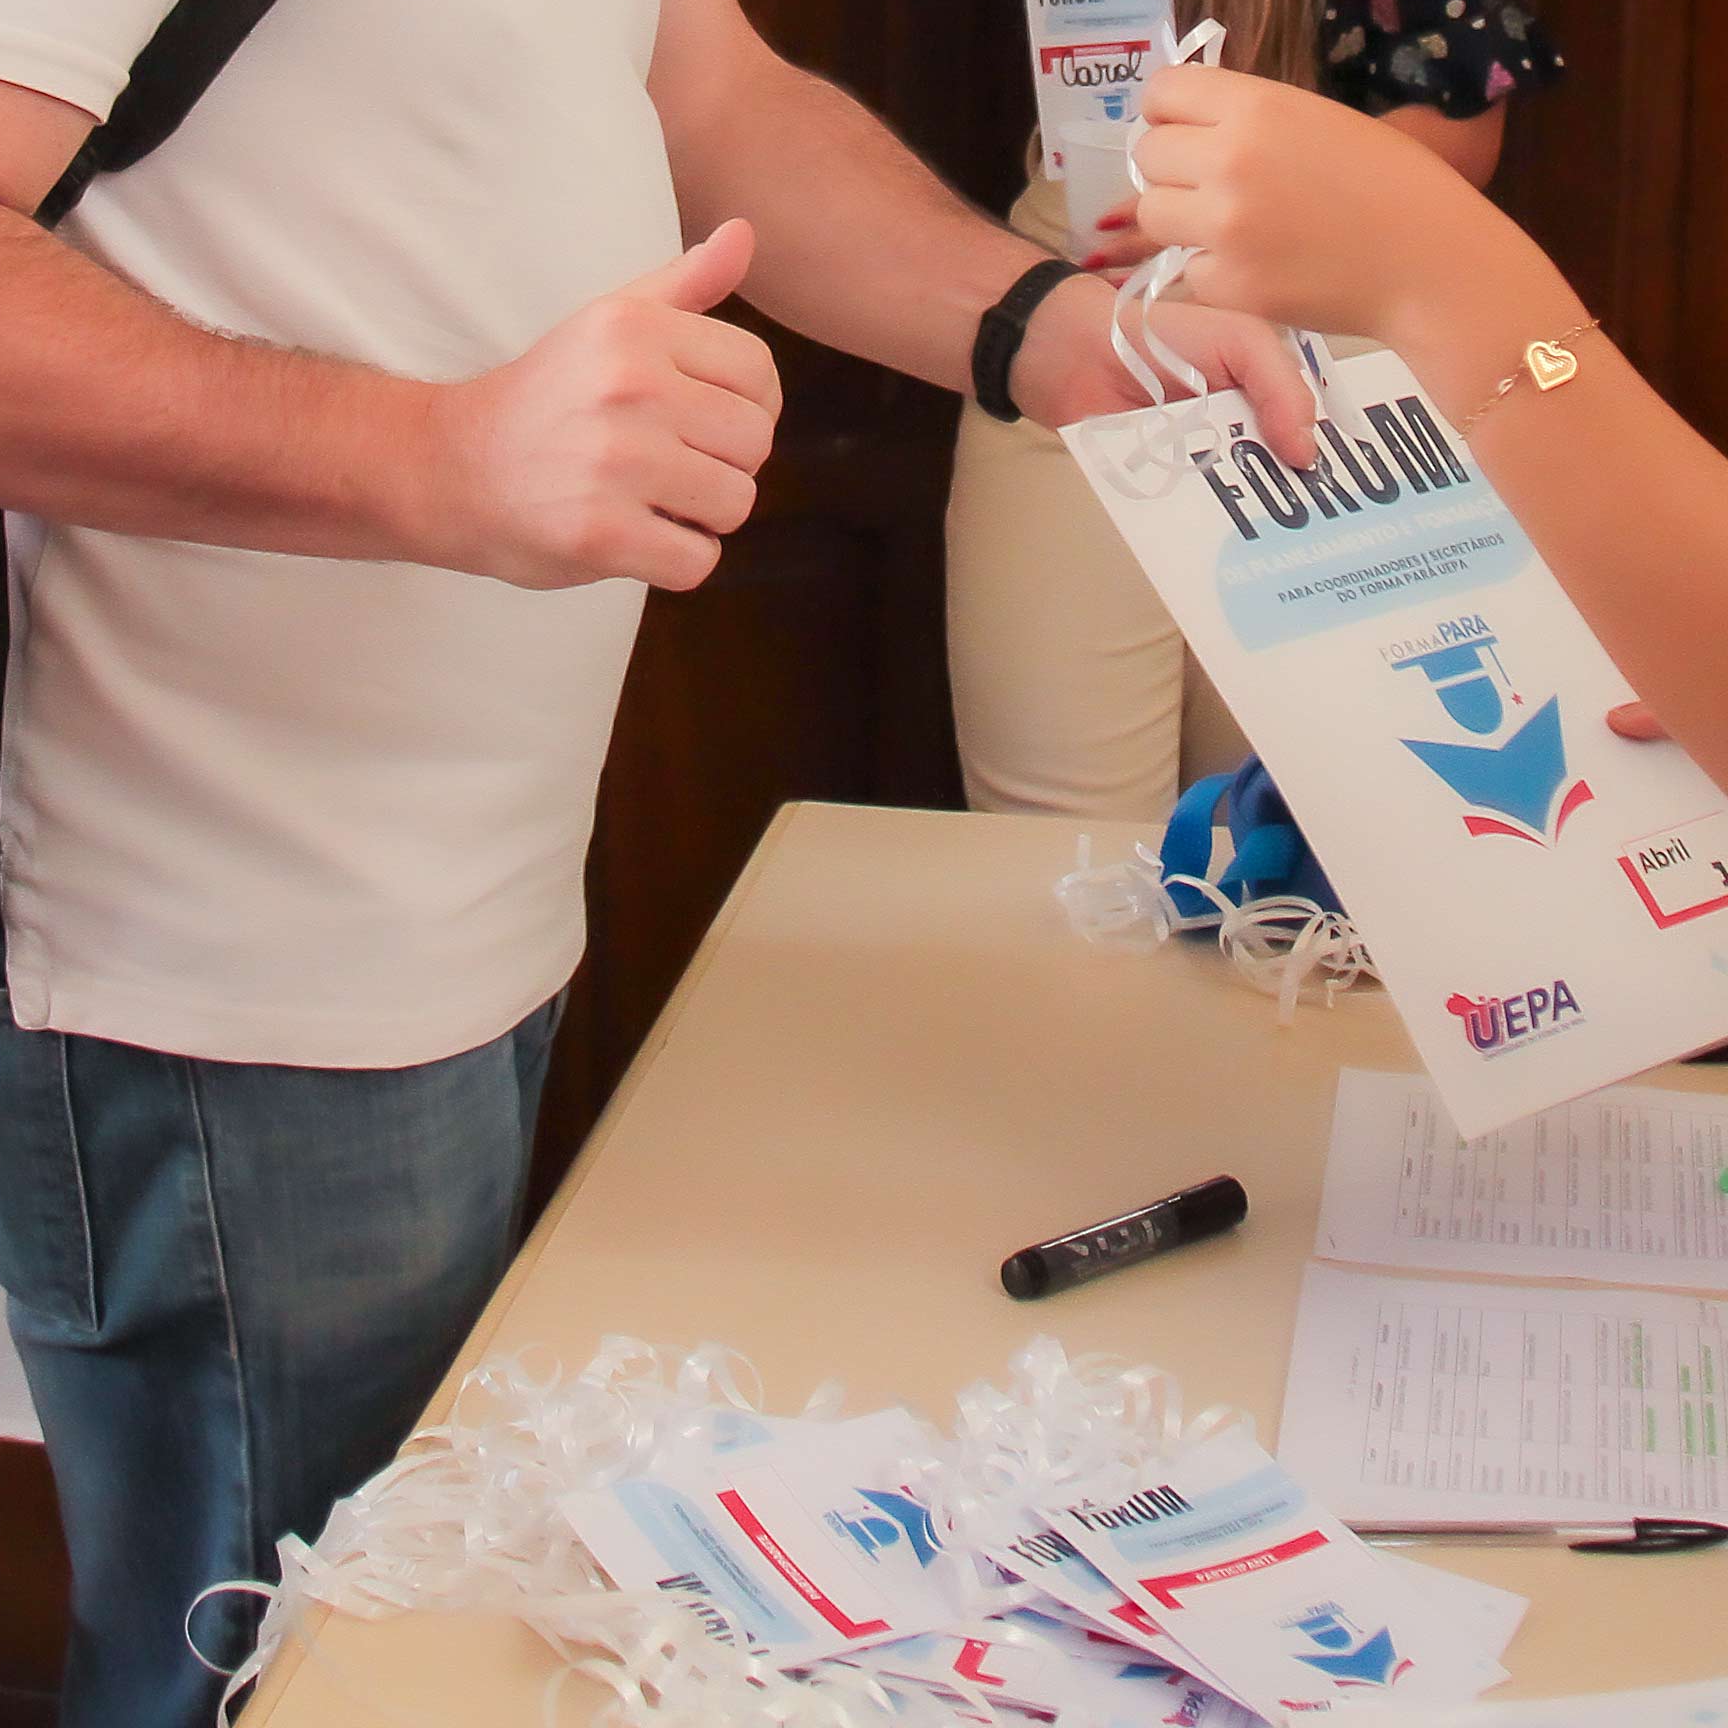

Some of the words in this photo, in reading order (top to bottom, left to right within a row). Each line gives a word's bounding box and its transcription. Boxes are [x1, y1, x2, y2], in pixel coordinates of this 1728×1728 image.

[1060, 48, 1143, 88] Carol
[1189, 395, 1471, 542] FÓRUM
[1277, 584, 1315, 604] PARA
[1315, 553, 1423, 593] COORDENADORES
[1335, 588, 1357, 604] DO
[1359, 575, 1405, 598] FORMA
[1438, 558, 1469, 576] UEPA
[1638, 837, 1693, 874] Abril
[1465, 978, 1583, 1053] UEPA
